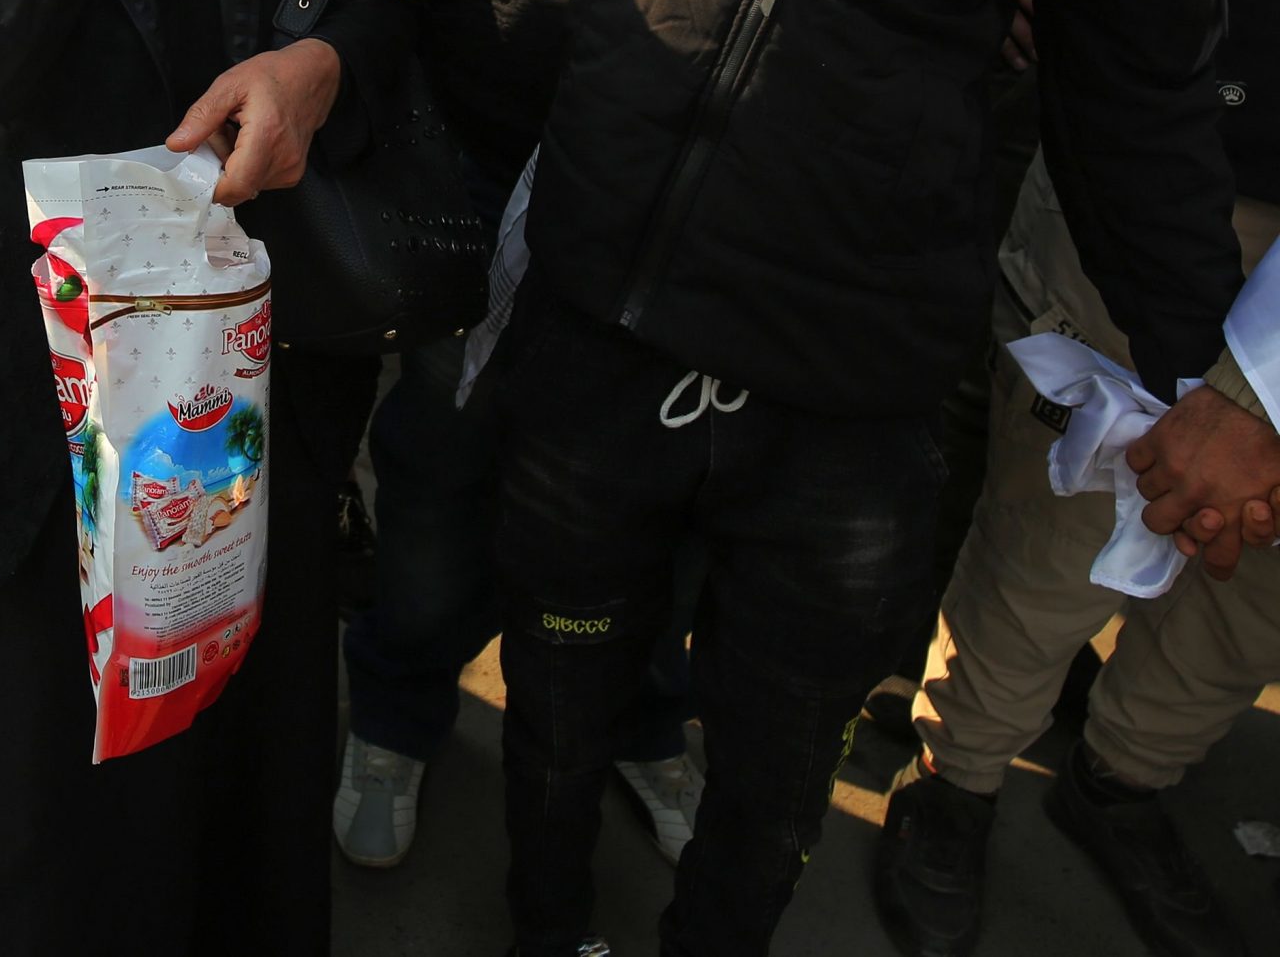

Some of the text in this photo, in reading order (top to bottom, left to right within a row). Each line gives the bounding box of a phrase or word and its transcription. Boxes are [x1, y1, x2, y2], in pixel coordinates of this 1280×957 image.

[179, 389, 229, 421] Mammi
[131, 563, 160, 582] Enjoy
[161, 563, 179, 577] the
[180, 548, 212, 573] smooth
[213, 540, 235, 560] sweet
